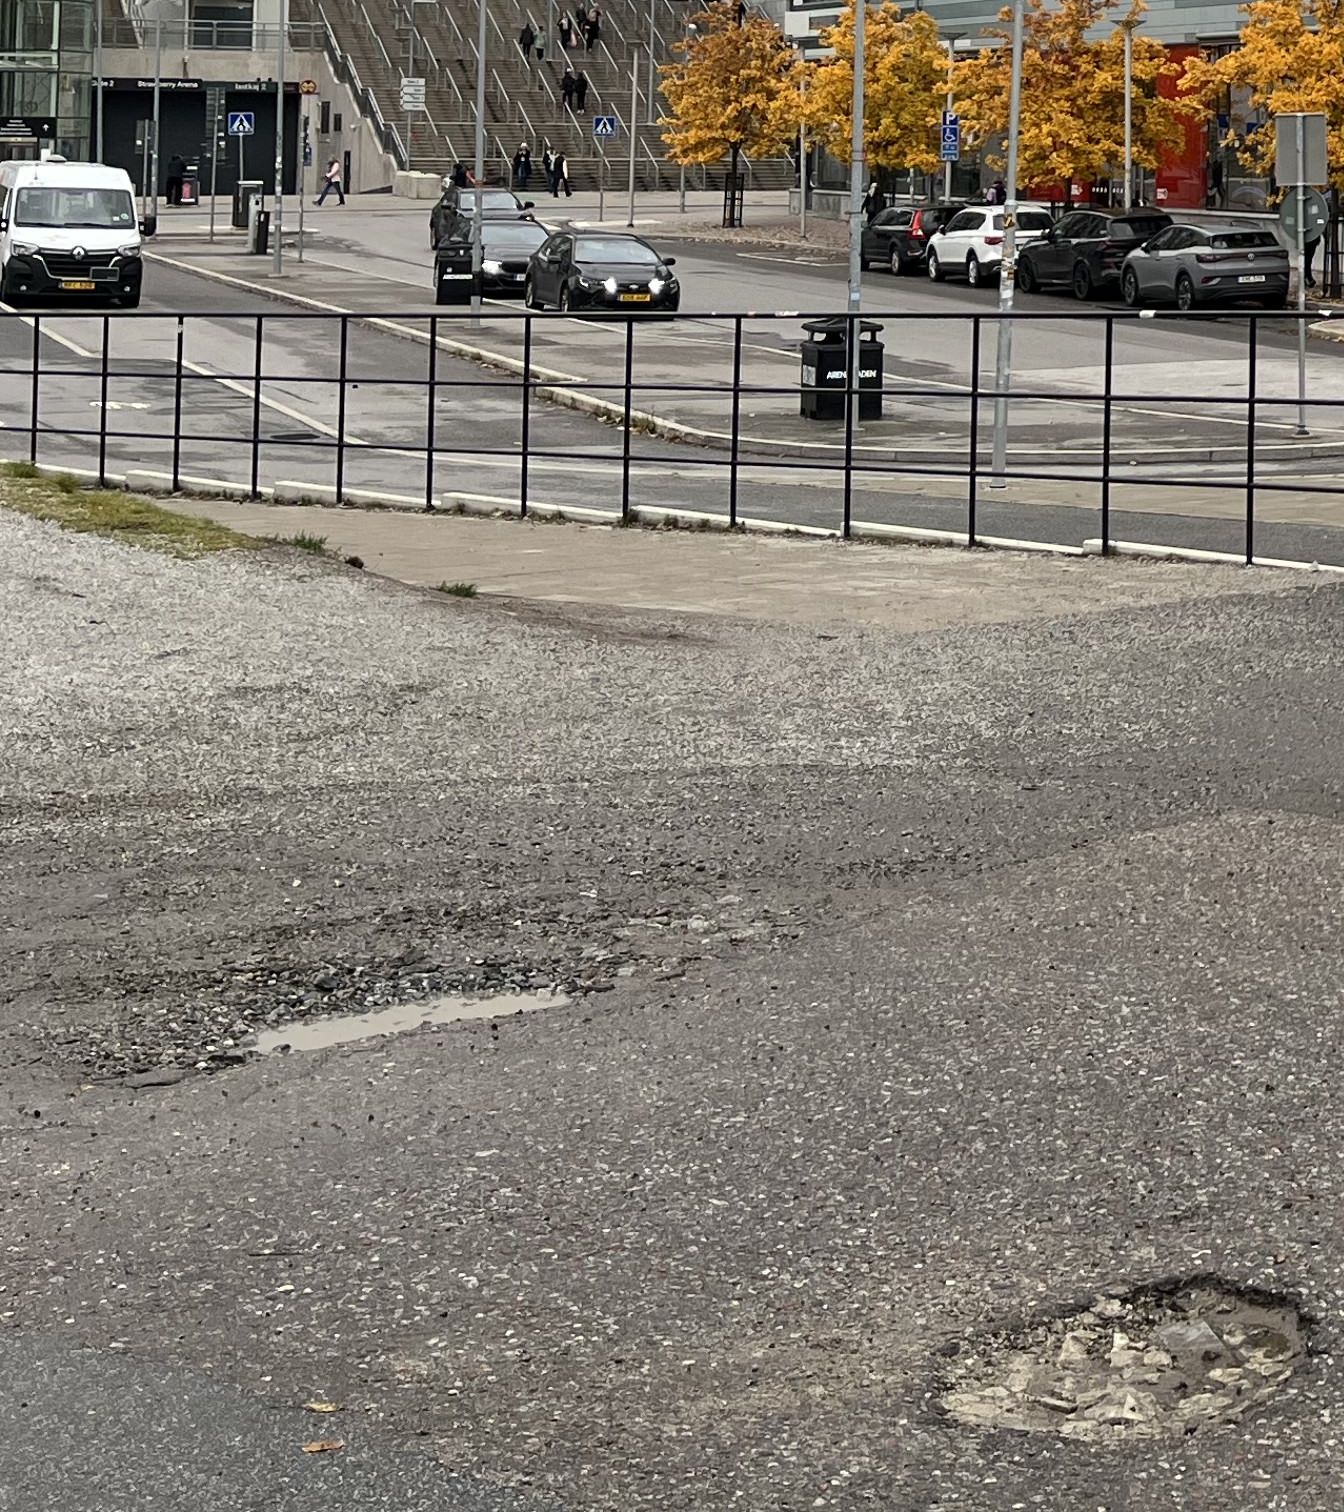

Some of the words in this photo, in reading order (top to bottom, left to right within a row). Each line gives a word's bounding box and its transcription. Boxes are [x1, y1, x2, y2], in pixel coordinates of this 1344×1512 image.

[137, 80, 176, 89] Straberry
[946, 112, 956, 125] P
[826, 370, 877, 380] ARENDEN
